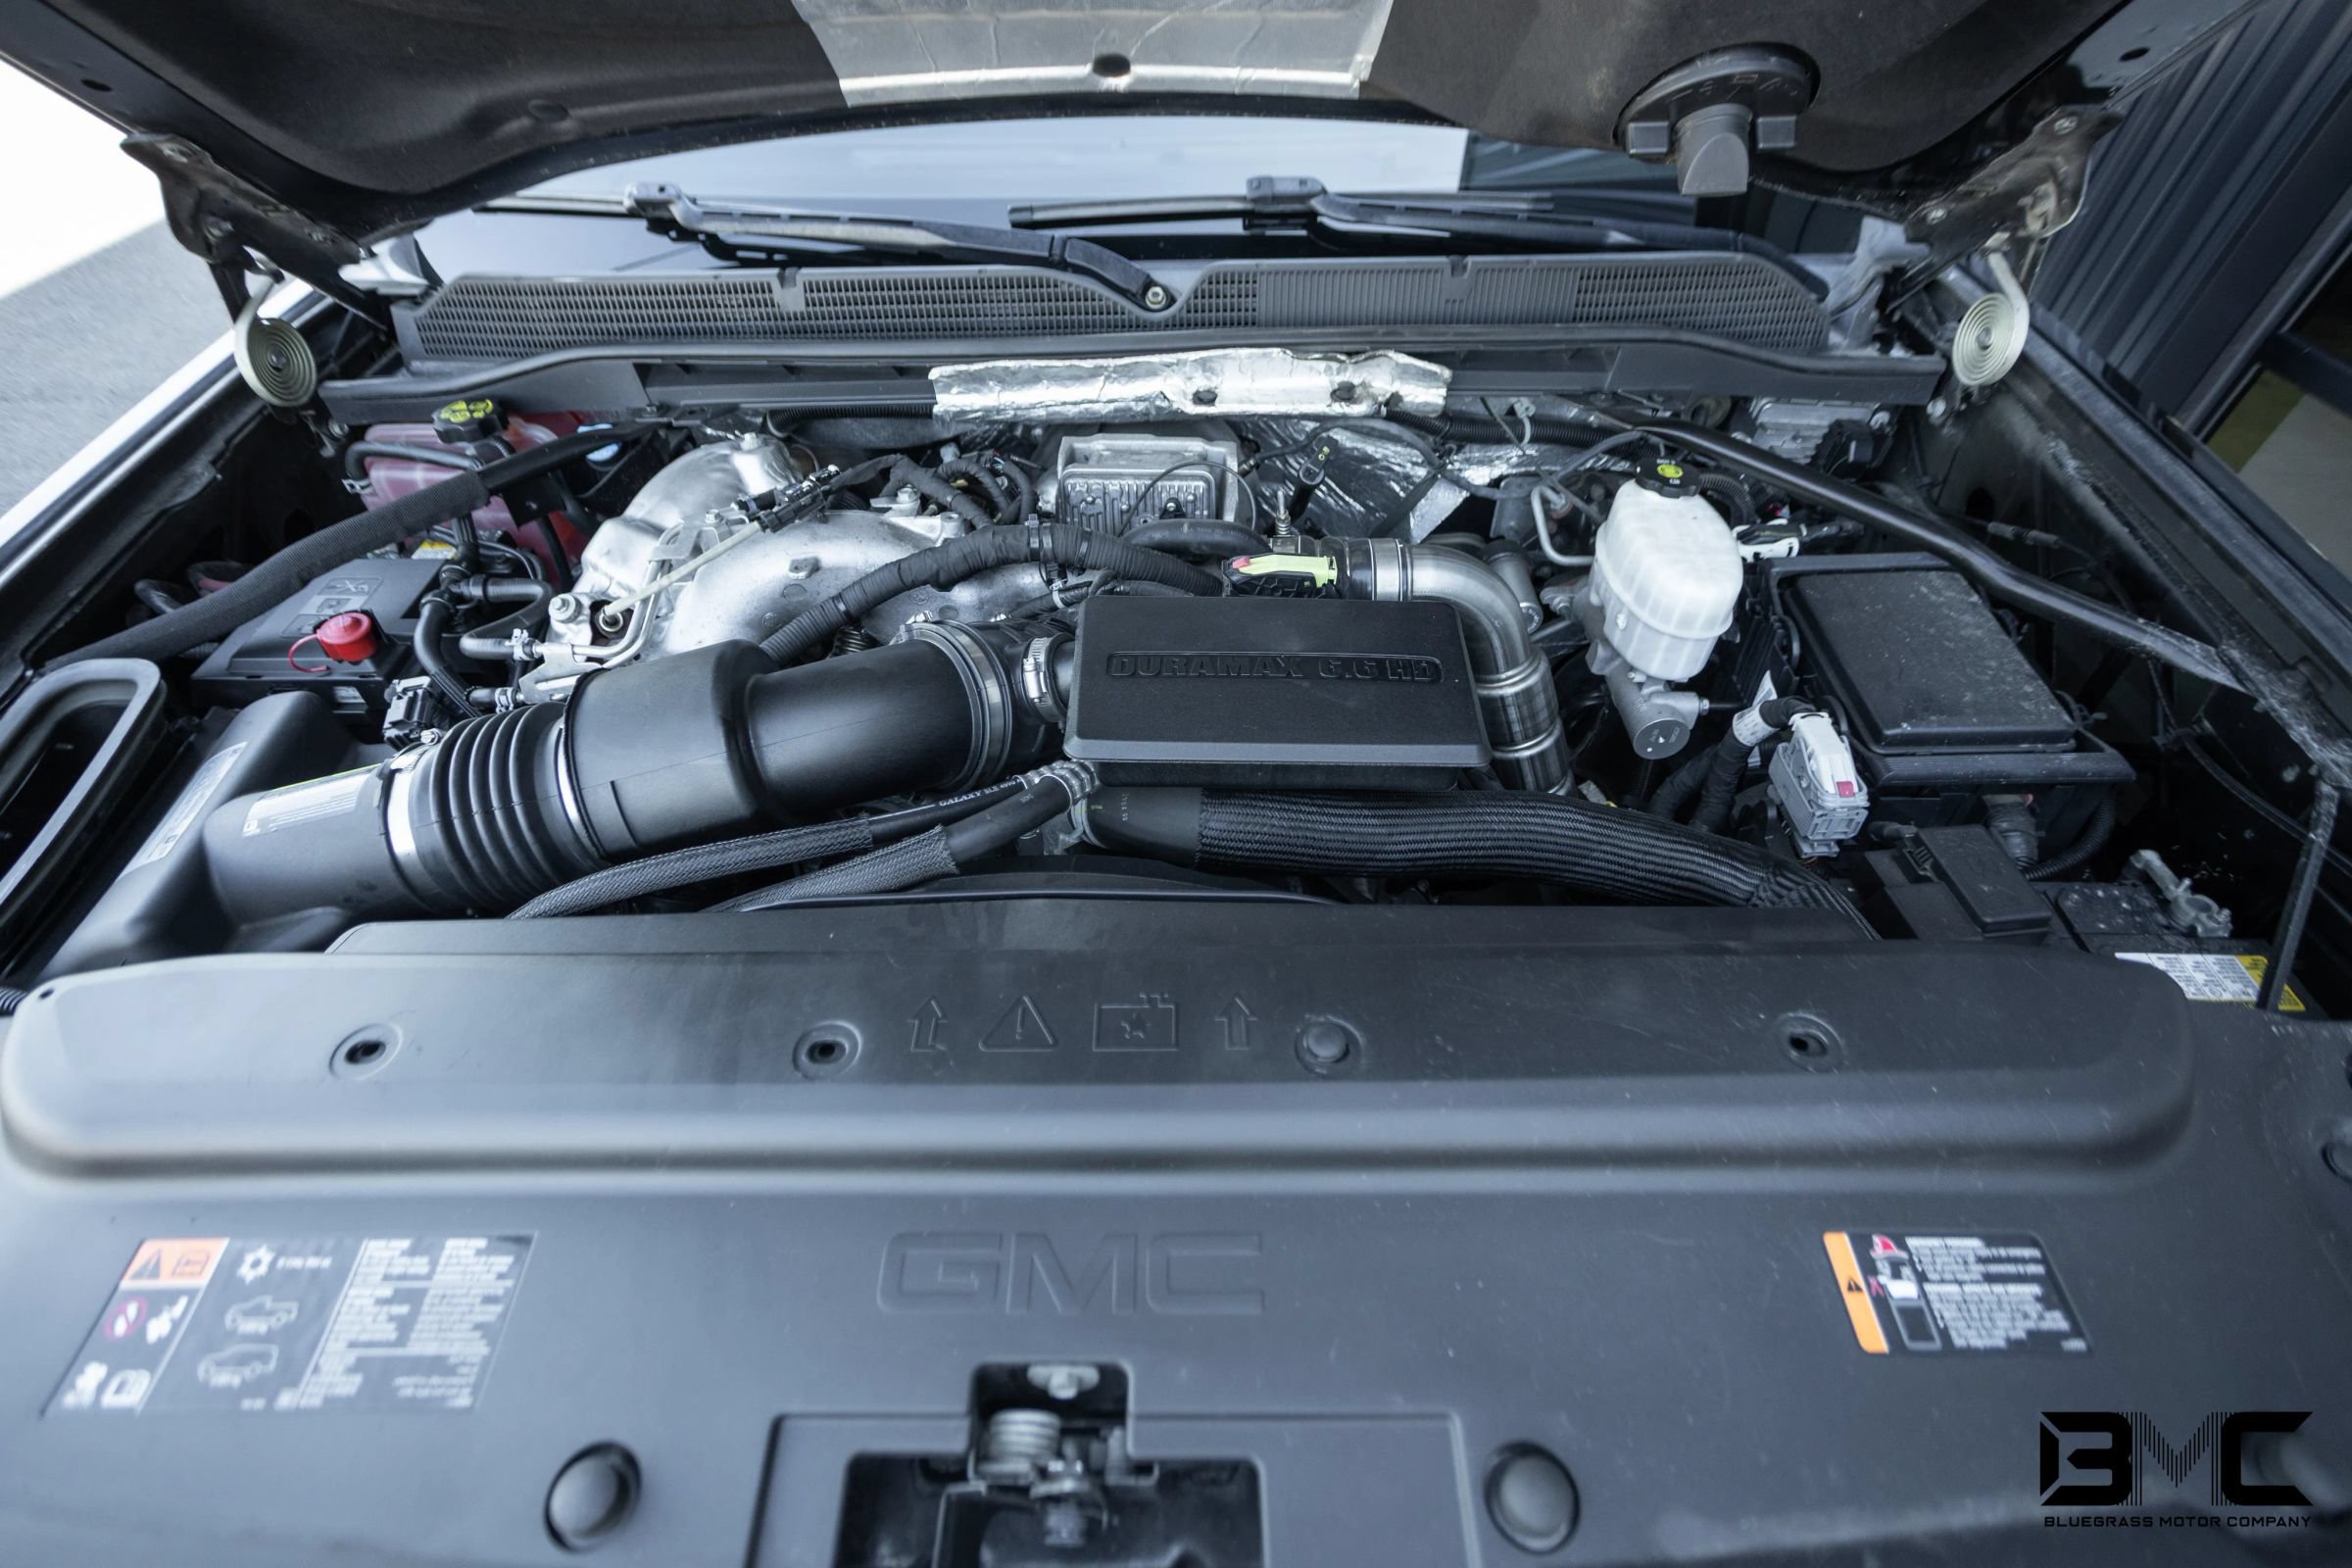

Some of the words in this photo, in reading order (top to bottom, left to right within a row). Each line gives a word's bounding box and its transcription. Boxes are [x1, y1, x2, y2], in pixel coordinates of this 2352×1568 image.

[1111, 656, 1303, 677] DURAMAX
[1318, 659, 1378, 679] 6.6
[1386, 659, 1440, 681] HD
[939, 791, 982, 807] GALAXY
[877, 1231, 1266, 1314] GMC
